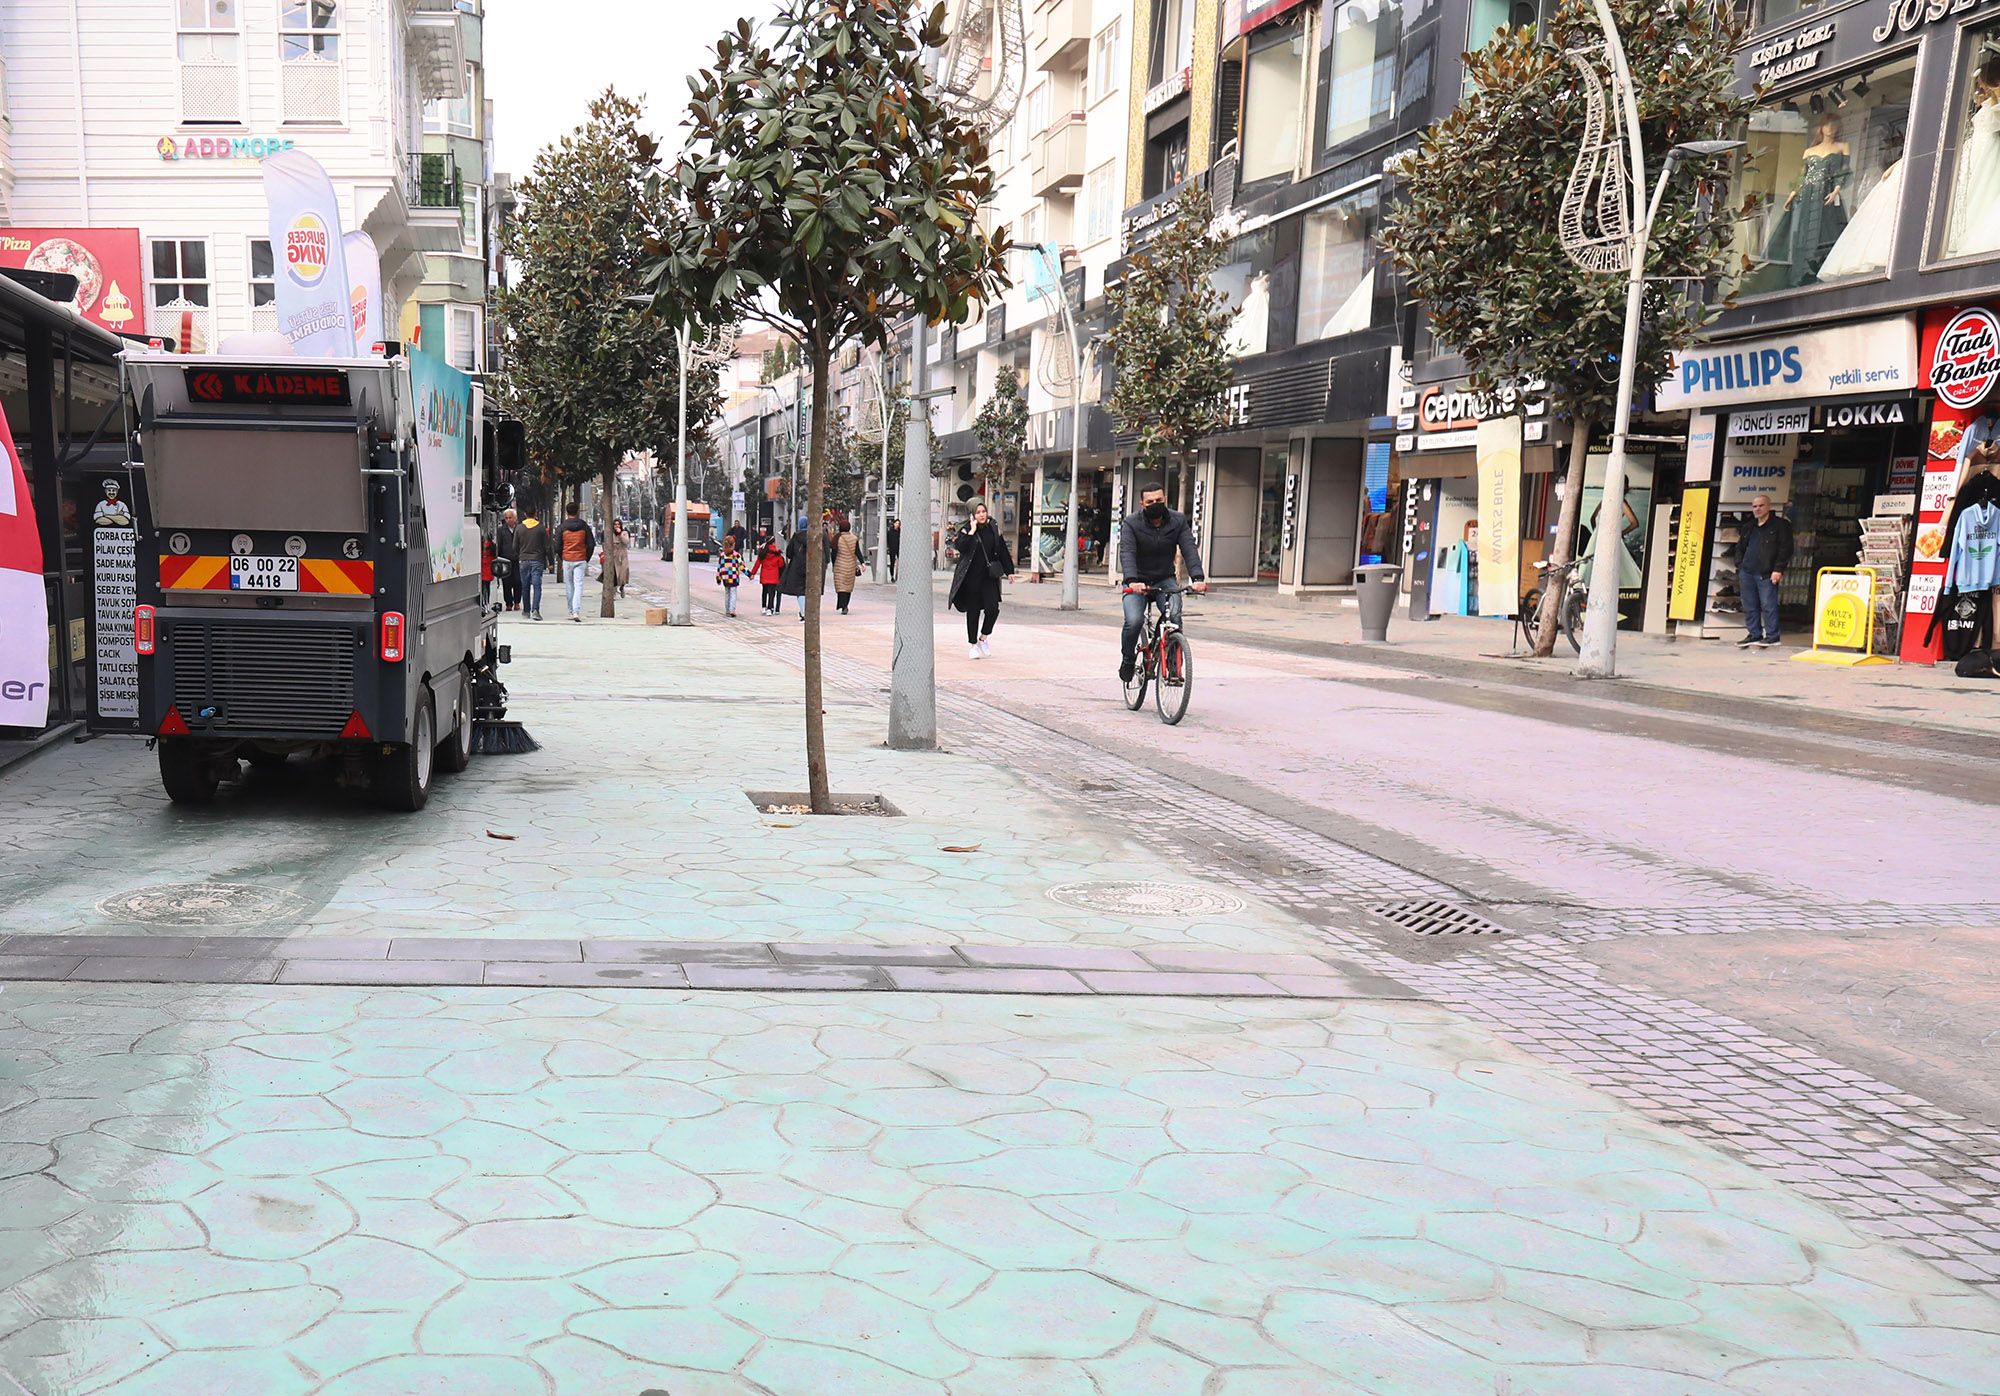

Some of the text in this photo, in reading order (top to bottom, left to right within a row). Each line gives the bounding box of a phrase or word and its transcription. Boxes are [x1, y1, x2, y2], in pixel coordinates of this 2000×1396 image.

[1796, 23, 1836, 51] ÖZEL
[1760, 51, 1820, 84] TASARIM
[1682, 346, 1900, 394] PHILIPS yetkili servis
[234, 375, 342, 395] KADEME
[1826, 403, 1905, 428] LOKKA
[1743, 413, 1809, 431] ÖNCÜ SAAT
[1691, 432, 1713, 441] PHILIPS
[1733, 466, 1787, 478] PHILIPS
[1881, 501, 1906, 509] gazete
[1283, 474, 1297, 549] arma
[96, 531, 120, 543] ÇORBA
[1682, 511, 1693, 555] EXPRESS
[96, 543, 116, 555] PİLAV
[96, 559, 114, 568] SADE
[233, 558, 295, 572] 06 00 22
[96, 572, 116, 582] KURU
[247, 574, 281, 588] 4418
[97, 585, 120, 595] SEBZE
[1911, 584, 1936, 593] BAKLAVA
[97, 598, 120, 607] TAVUK
[1920, 595, 1935, 611] 80
[98, 609, 120, 619] TAVUK
[98, 649, 121, 658] CACIK
[99, 662, 117, 672] TATLI
[99, 676, 126, 686] SALATA
[99, 689, 115, 701] ŞİŞE
